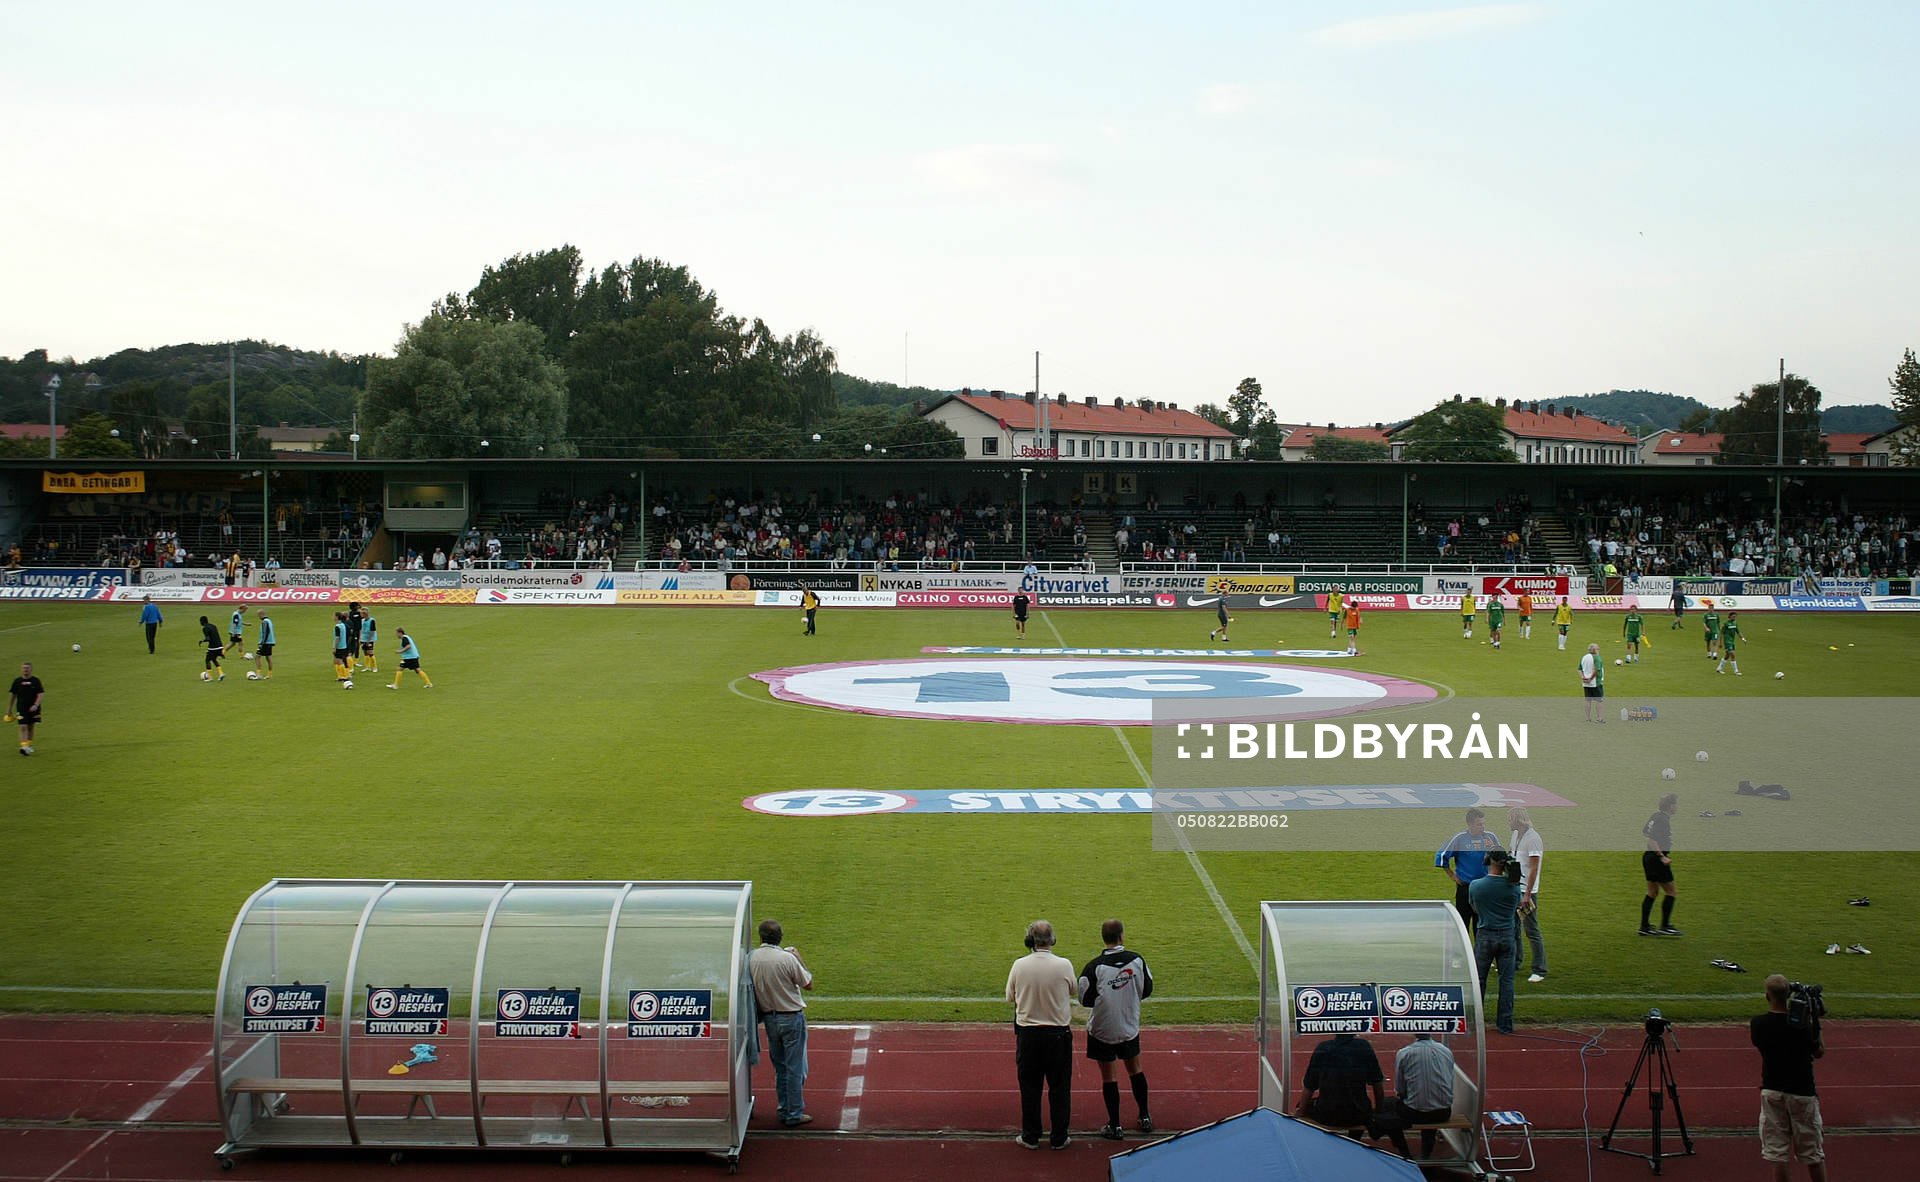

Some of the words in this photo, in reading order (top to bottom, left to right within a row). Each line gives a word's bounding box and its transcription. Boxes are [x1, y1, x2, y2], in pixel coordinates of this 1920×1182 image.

[24, 571, 123, 587] www.af.se
[461, 574, 569, 585] Socialdemokraterna
[753, 577, 852, 590] FöreningsSparbanken
[927, 579, 953, 587] ALLT
[961, 579, 992, 587] MARK
[1021, 576, 1110, 593] Cityvarvet
[1514, 579, 1558, 589] KUMHO
[880, 580, 923, 590] NYKAB
[1265, 584, 1291, 592] CITY
[1347, 583, 1362, 592] AB
[1364, 583, 1418, 592] POSEIDON
[1680, 581, 1727, 595] STADIUM
[1742, 581, 1789, 595] STADIUM
[232, 588, 331, 600] vodafone
[512, 592, 603, 600] SPEKTRUM
[898, 594, 950, 603] CASINO
[1039, 595, 1152, 606] svenskaspel.se
[1779, 598, 1859, 608] Björnkläder
[852, 669, 1303, 702] 13
[772, 795, 886, 809] 13
[300, 990, 311, 1000] ÄR
[422, 993, 434, 1003] ÄR
[553, 996, 565, 1005] ÄR
[1350, 992, 1362, 1001] ÄR
[1436, 992, 1448, 1001] ÄR
[252, 996, 269, 1008] 13
[275, 1000, 322, 1010] RESPEKT
[374, 997, 392, 1008] 13
[504, 1000, 522, 1011] 13
[636, 1000, 654, 1011] 13
[684, 996, 697, 1006] ÄR
[1302, 996, 1320, 1008] 13
[1327, 1001, 1373, 1011] RESPEKT
[1388, 995, 1406, 1008] 13
[1413, 1001, 1459, 1010] RESPEKT
[398, 1003, 444, 1013] RESPEKT
[528, 1005, 575, 1015] RESPEKT
[660, 1005, 706, 1016] RESPEKT
[246, 1019, 309, 1031] STRYKTIPSET
[369, 1021, 432, 1033] STRYKTIPSET
[500, 1024, 562, 1036] STRYKTIPSET
[632, 1024, 694, 1036] STRYKTIPSET
[1300, 1020, 1362, 1032] STRYKTIPSET
[1386, 1020, 1449, 1031] STRYKTIPSET
